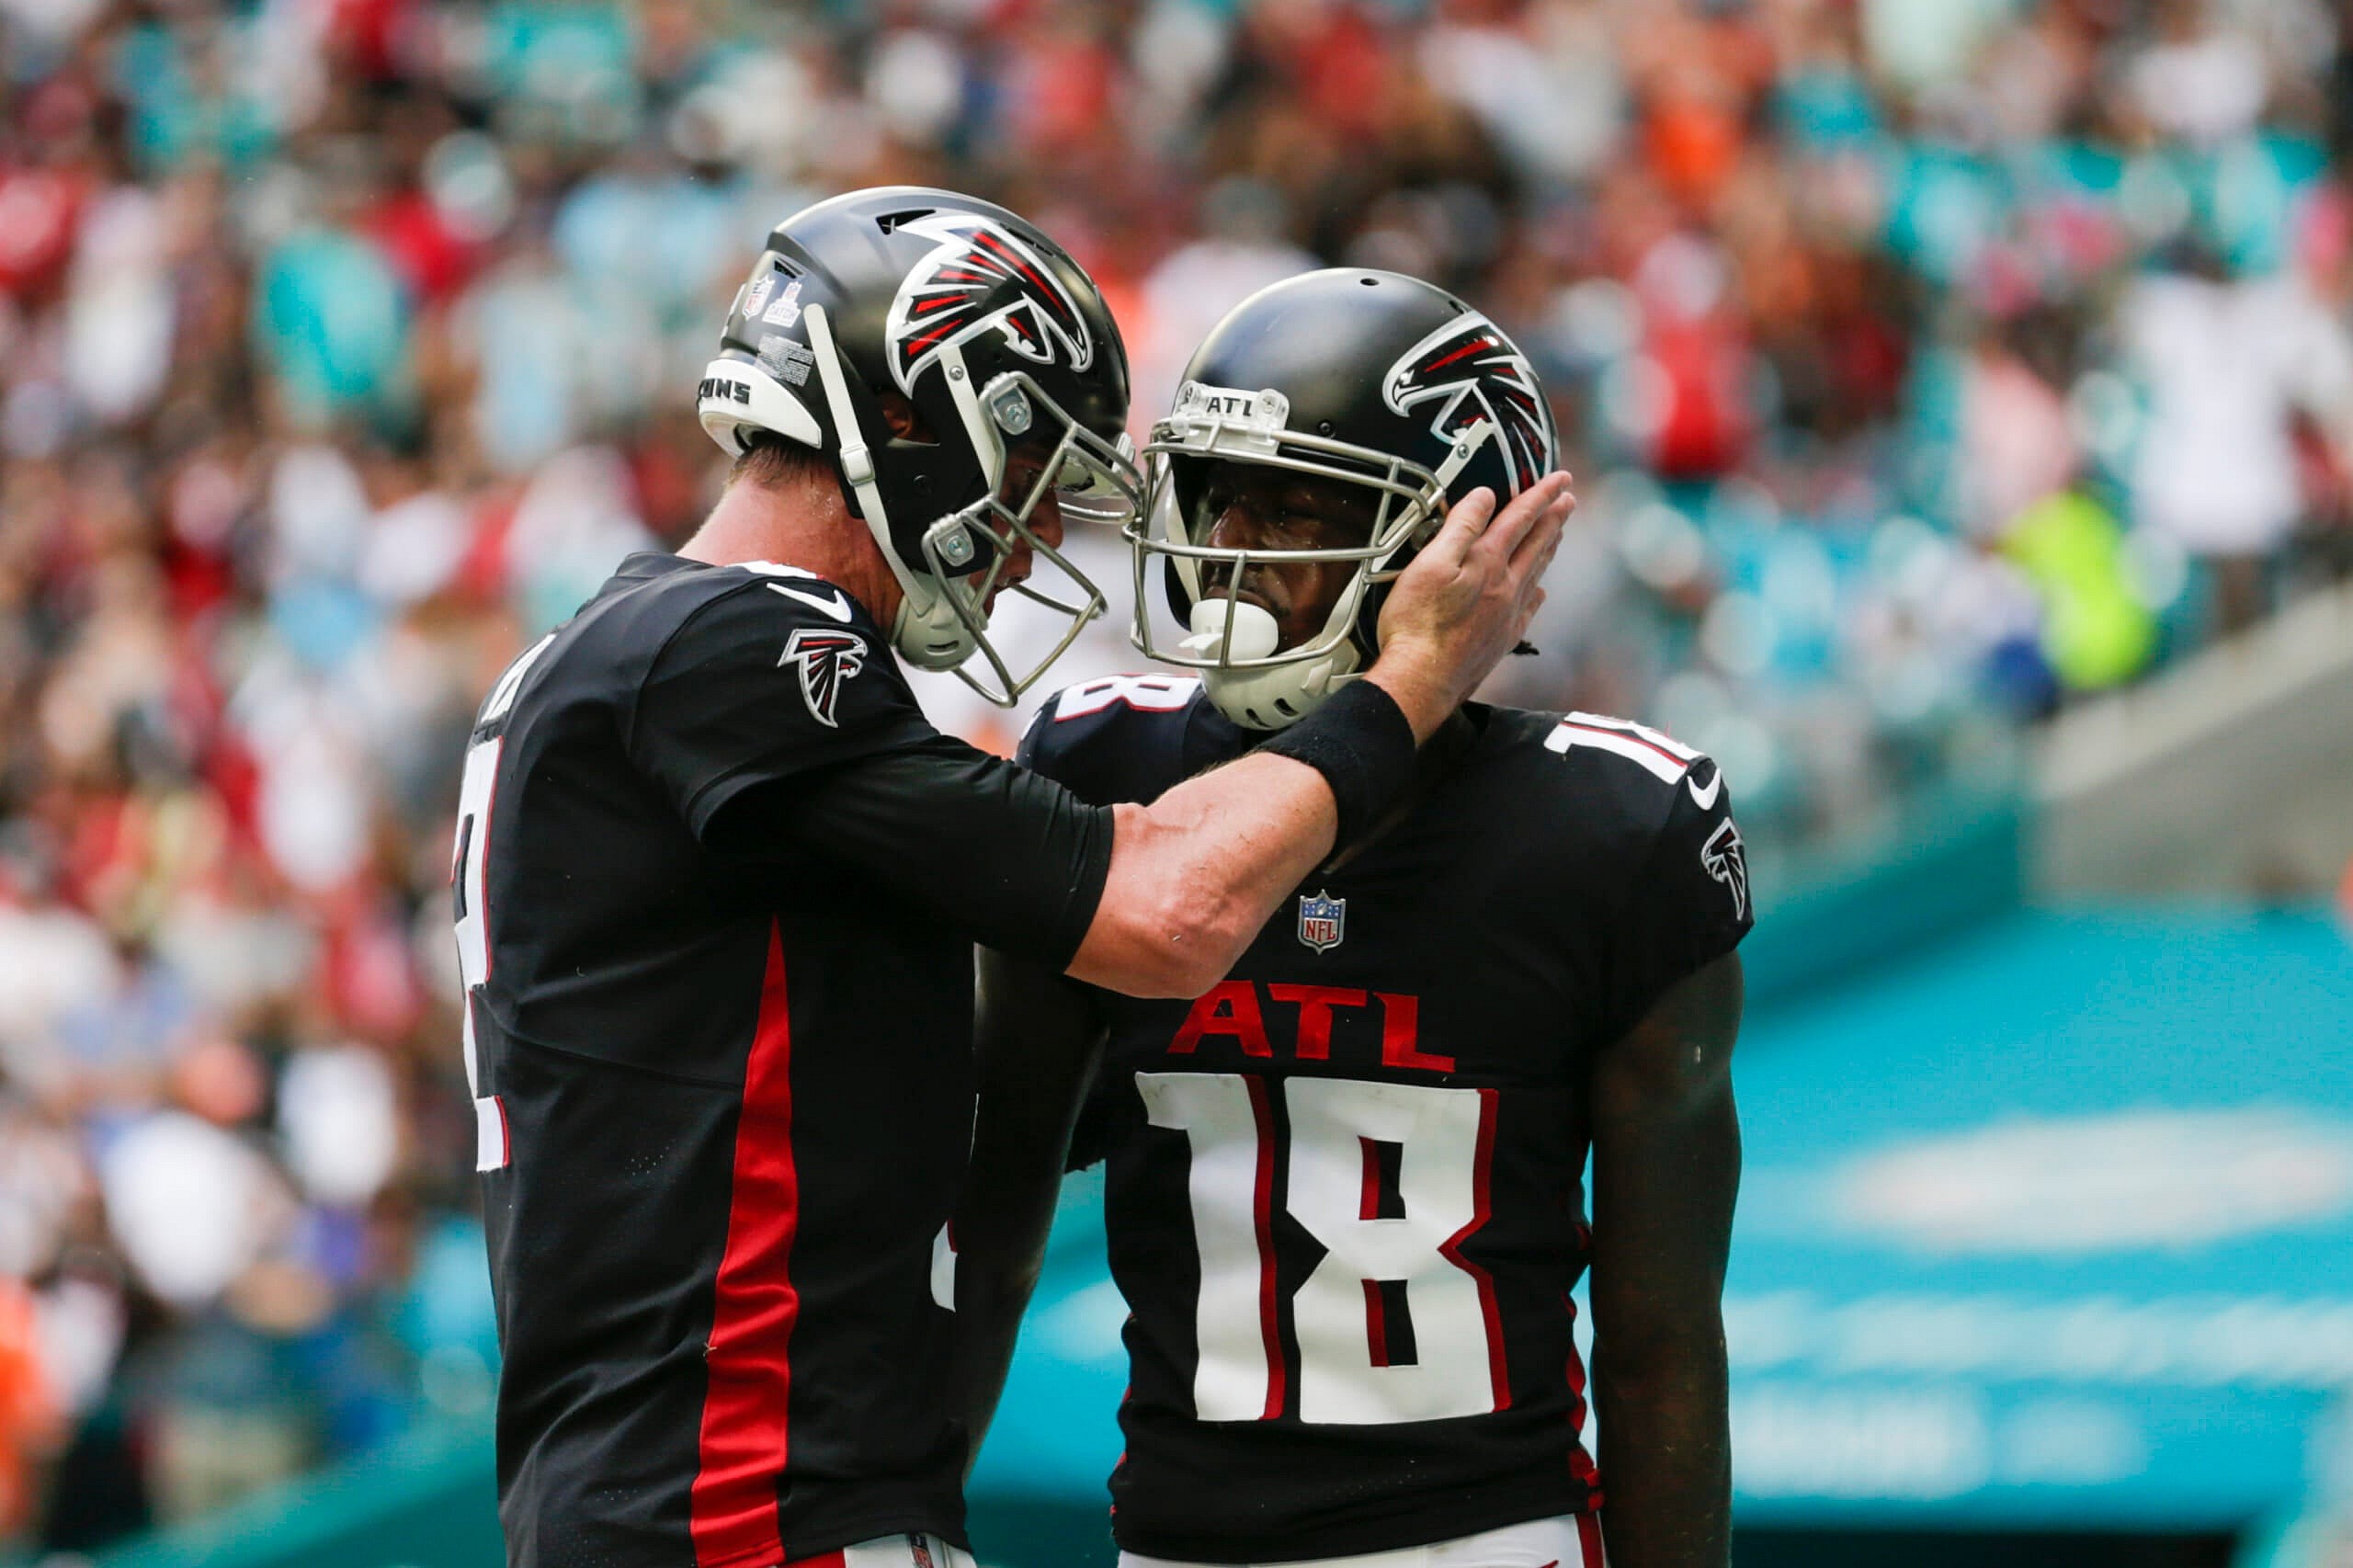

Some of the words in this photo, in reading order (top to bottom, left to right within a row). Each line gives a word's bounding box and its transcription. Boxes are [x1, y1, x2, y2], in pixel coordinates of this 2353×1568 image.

[1206, 397, 1253, 417] ATL
[1304, 920, 1336, 943] NFL
[1166, 979, 1457, 1074] ATL
[1134, 1071, 1512, 1425] 18
